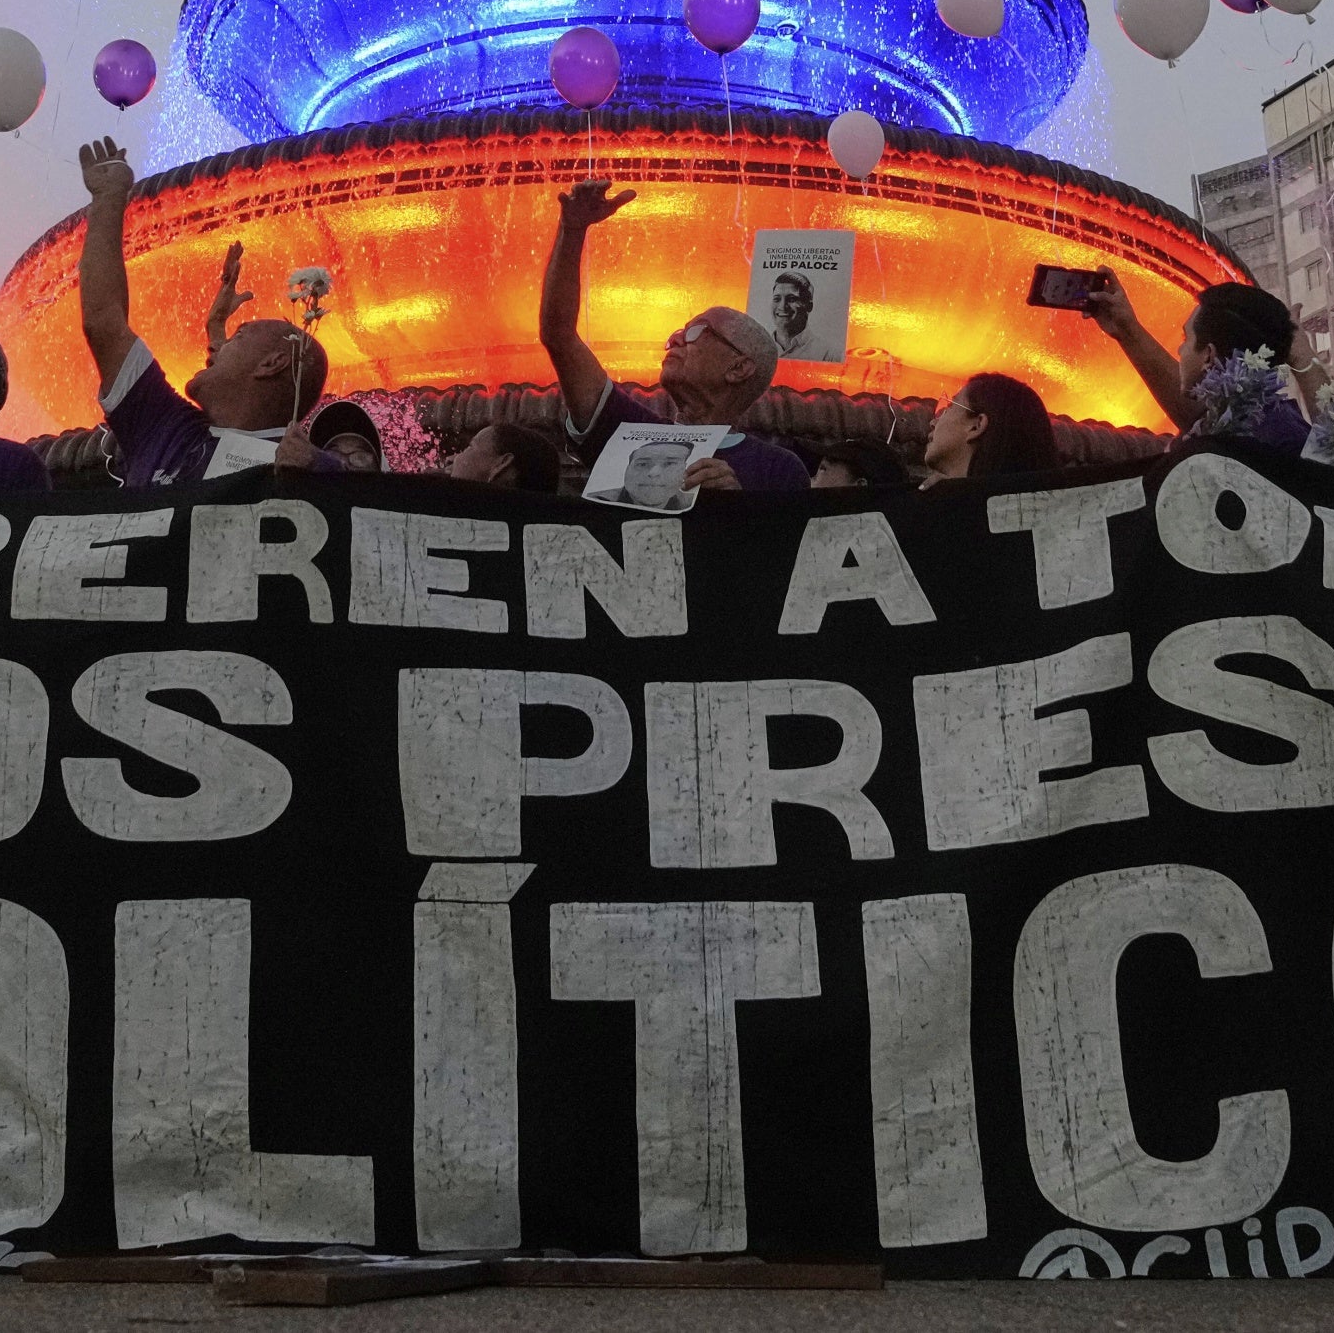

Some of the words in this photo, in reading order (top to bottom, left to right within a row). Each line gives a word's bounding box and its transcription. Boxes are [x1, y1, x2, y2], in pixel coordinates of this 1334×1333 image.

[803, 247, 841, 255] LIBERTAD
[762, 260, 788, 269] LUIS
[790, 261, 838, 271] PALOCZ
[777, 511, 937, 635] A
